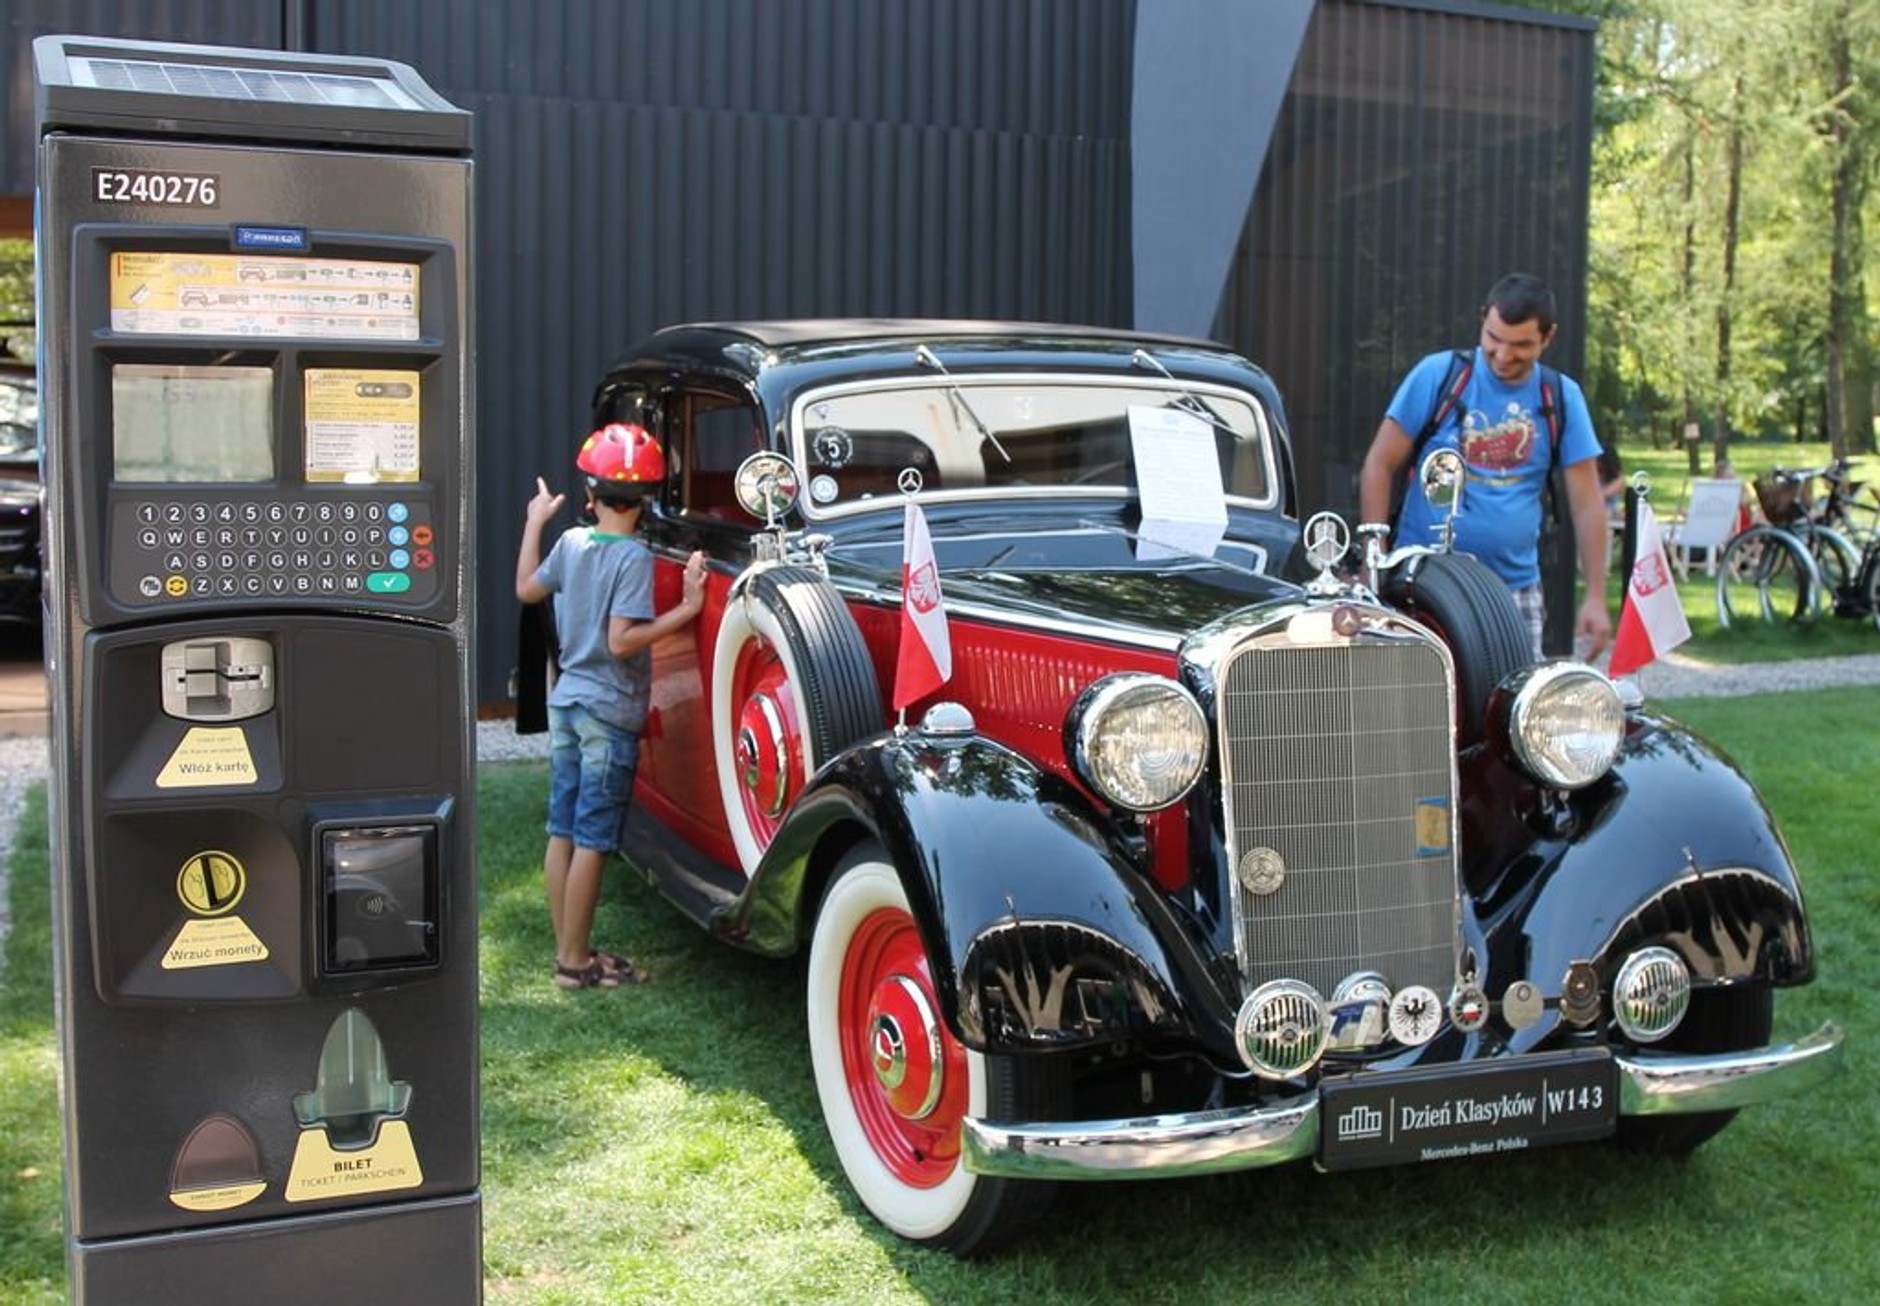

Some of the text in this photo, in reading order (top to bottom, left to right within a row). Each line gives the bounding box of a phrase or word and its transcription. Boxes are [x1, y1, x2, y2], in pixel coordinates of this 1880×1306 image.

[98, 172, 216, 204] E240276
[823, 436, 840, 458] 5
[145, 506, 378, 520] 1 2 3 4 5 6 7 8 9 0
[143, 531, 379, 544] Q W E R T Y U I O P
[171, 554, 380, 567] A S D F G H J K L
[198, 577, 357, 591] Z X C V B N M
[215, 761, 249, 774] kartę
[170, 943, 264, 961] Wrzuć monety
[1401, 1085, 1603, 1131] Dzień Klasyków W143
[334, 1158, 372, 1172] BILET
[301, 1175, 335, 1188] TICKET
[345, 1168, 406, 1182] PARKSCHEIN
